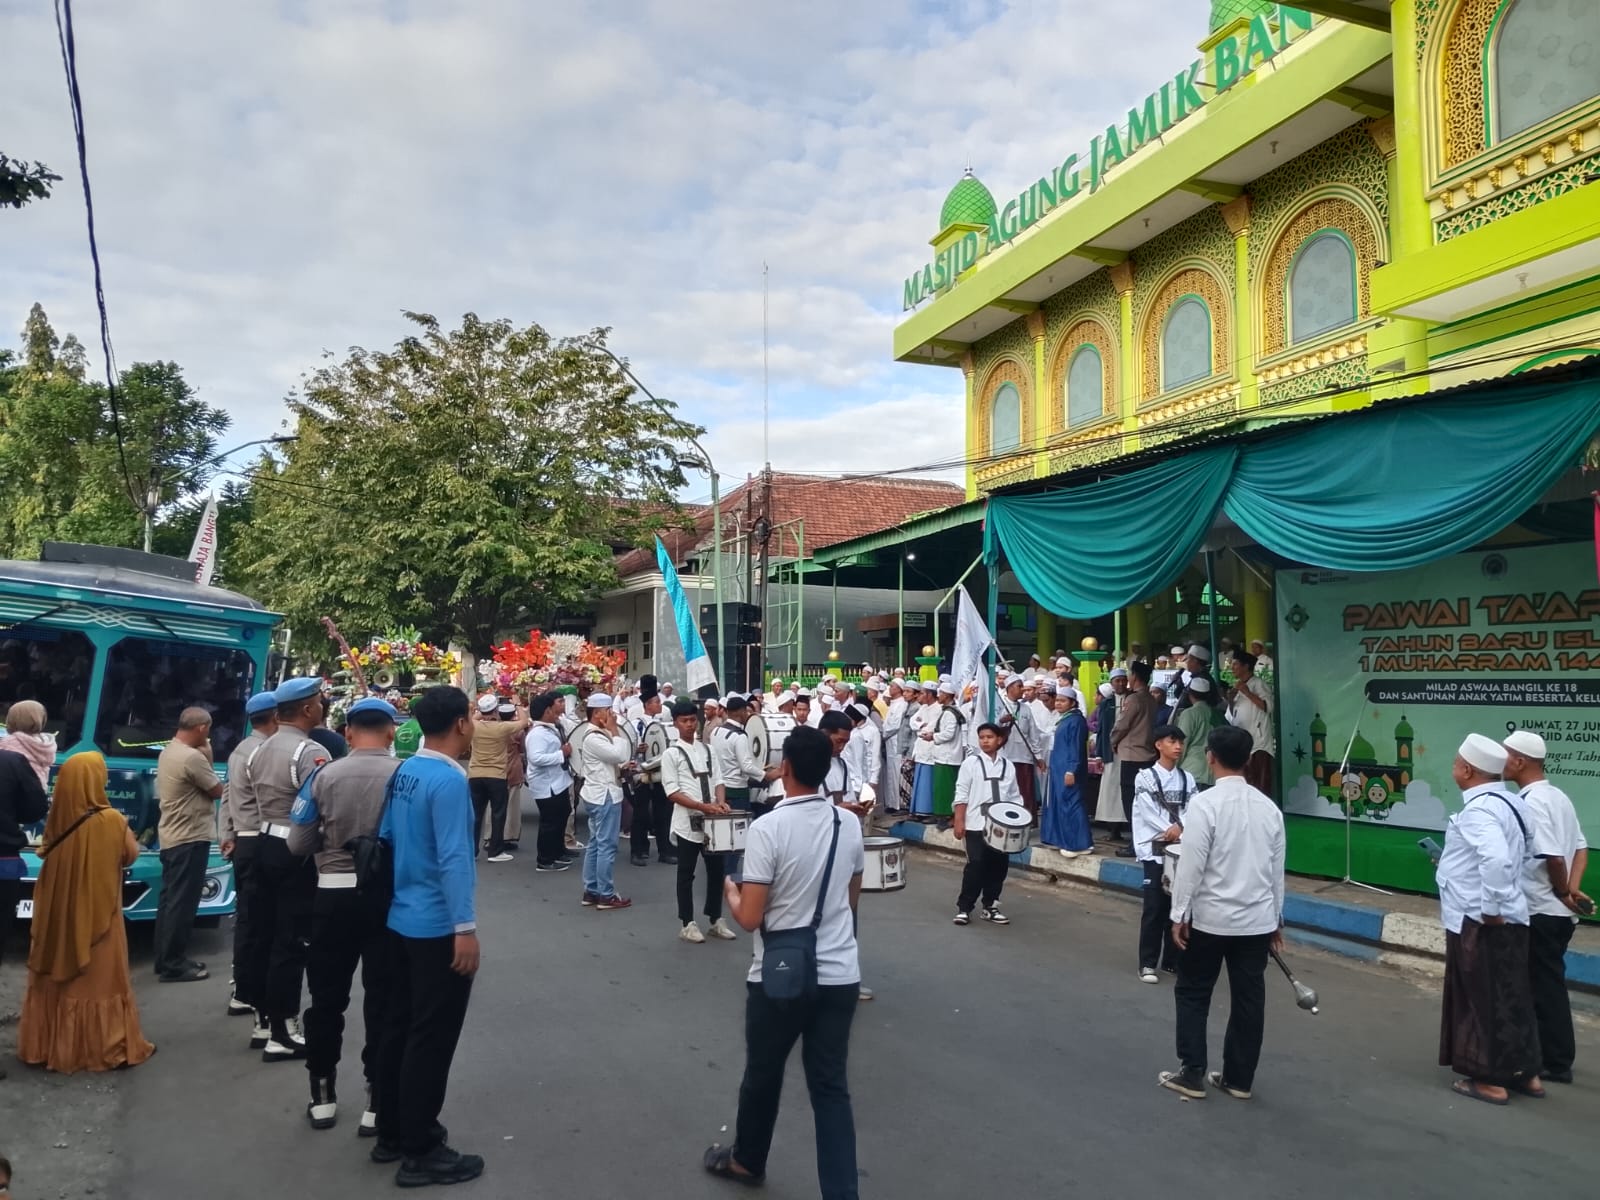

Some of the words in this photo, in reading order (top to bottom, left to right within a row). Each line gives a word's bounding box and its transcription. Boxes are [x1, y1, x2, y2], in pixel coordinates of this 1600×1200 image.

[903, 231, 979, 312] MASJID
[985, 153, 1082, 256] AGUNG
[1089, 58, 1208, 195] JAMIK
[1343, 597, 1471, 632] PAWAI
[1359, 634, 1454, 654] TAHUN
[1458, 631, 1548, 651] BARU
[1359, 656, 1370, 672] 1
[1374, 652, 1553, 672] MUHARRAM
[1378, 691, 1400, 700] DAN
[1401, 691, 1457, 701] SANTUNAN
[1458, 692, 1488, 701] ANAK
[1489, 692, 1522, 701] YATIM
[1525, 693, 1573, 702] BESERTA
[1425, 683, 1458, 692] MILAD
[1460, 683, 1500, 692] ASWAJA
[1503, 683, 1543, 692] BANGIL
[1547, 684, 1560, 692] KE
[1564, 683, 1577, 692] 18
[1565, 721, 1579, 731] 27
[1582, 721, 1600, 731] JU
